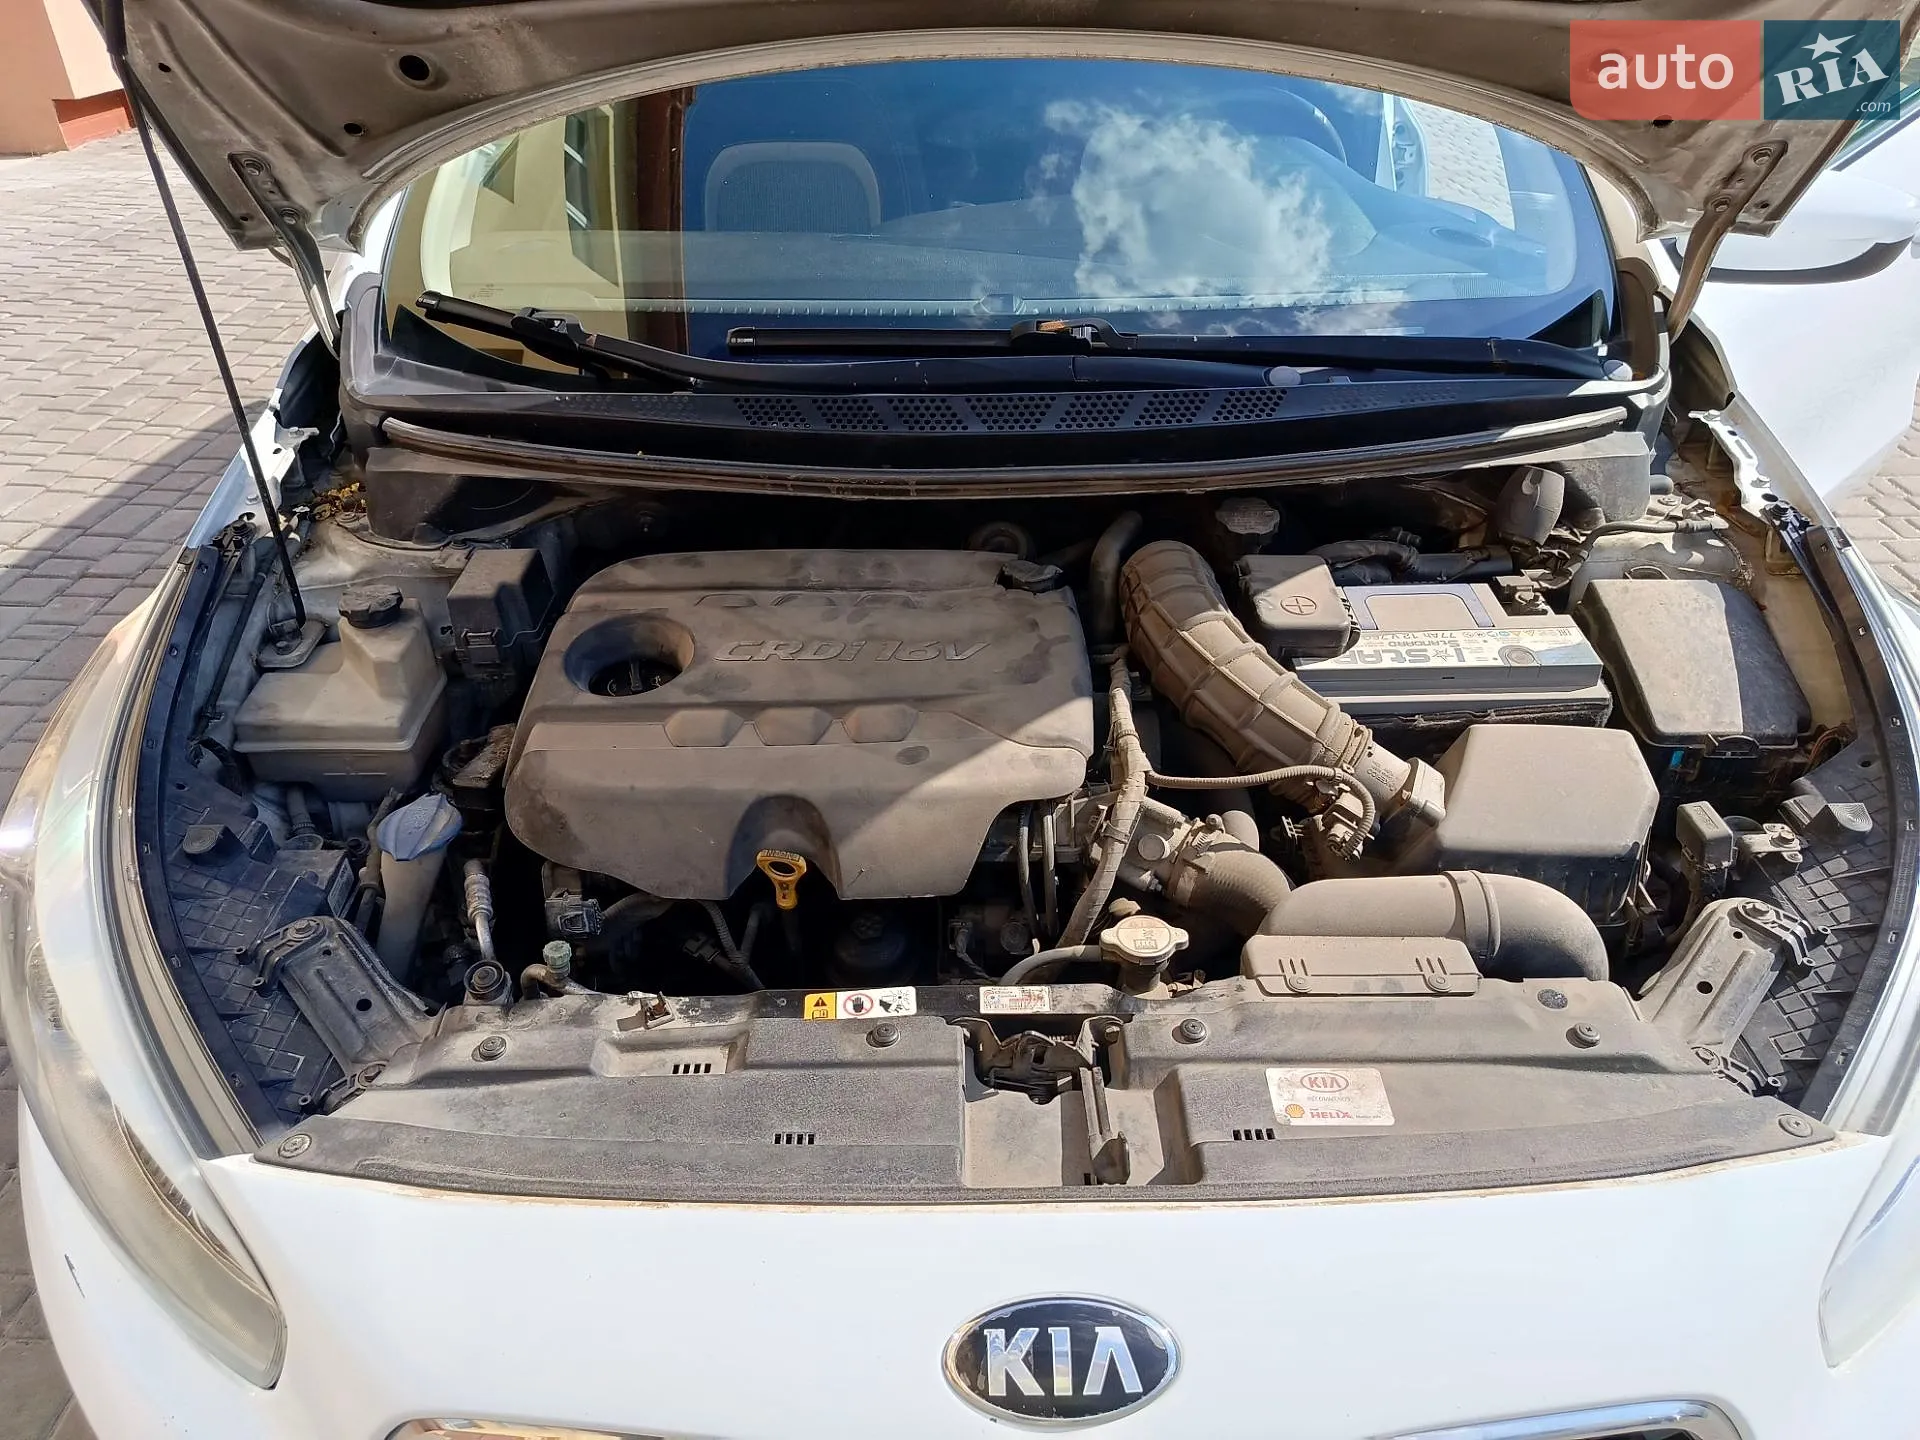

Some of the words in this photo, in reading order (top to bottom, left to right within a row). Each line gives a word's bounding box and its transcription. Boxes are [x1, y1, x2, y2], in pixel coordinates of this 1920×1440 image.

[875, 640, 992, 662] 16V
[1308, 1076, 1342, 1089] KIA
[1310, 1111, 1352, 1119] HELIX
[984, 1326, 1144, 1397] KIA
